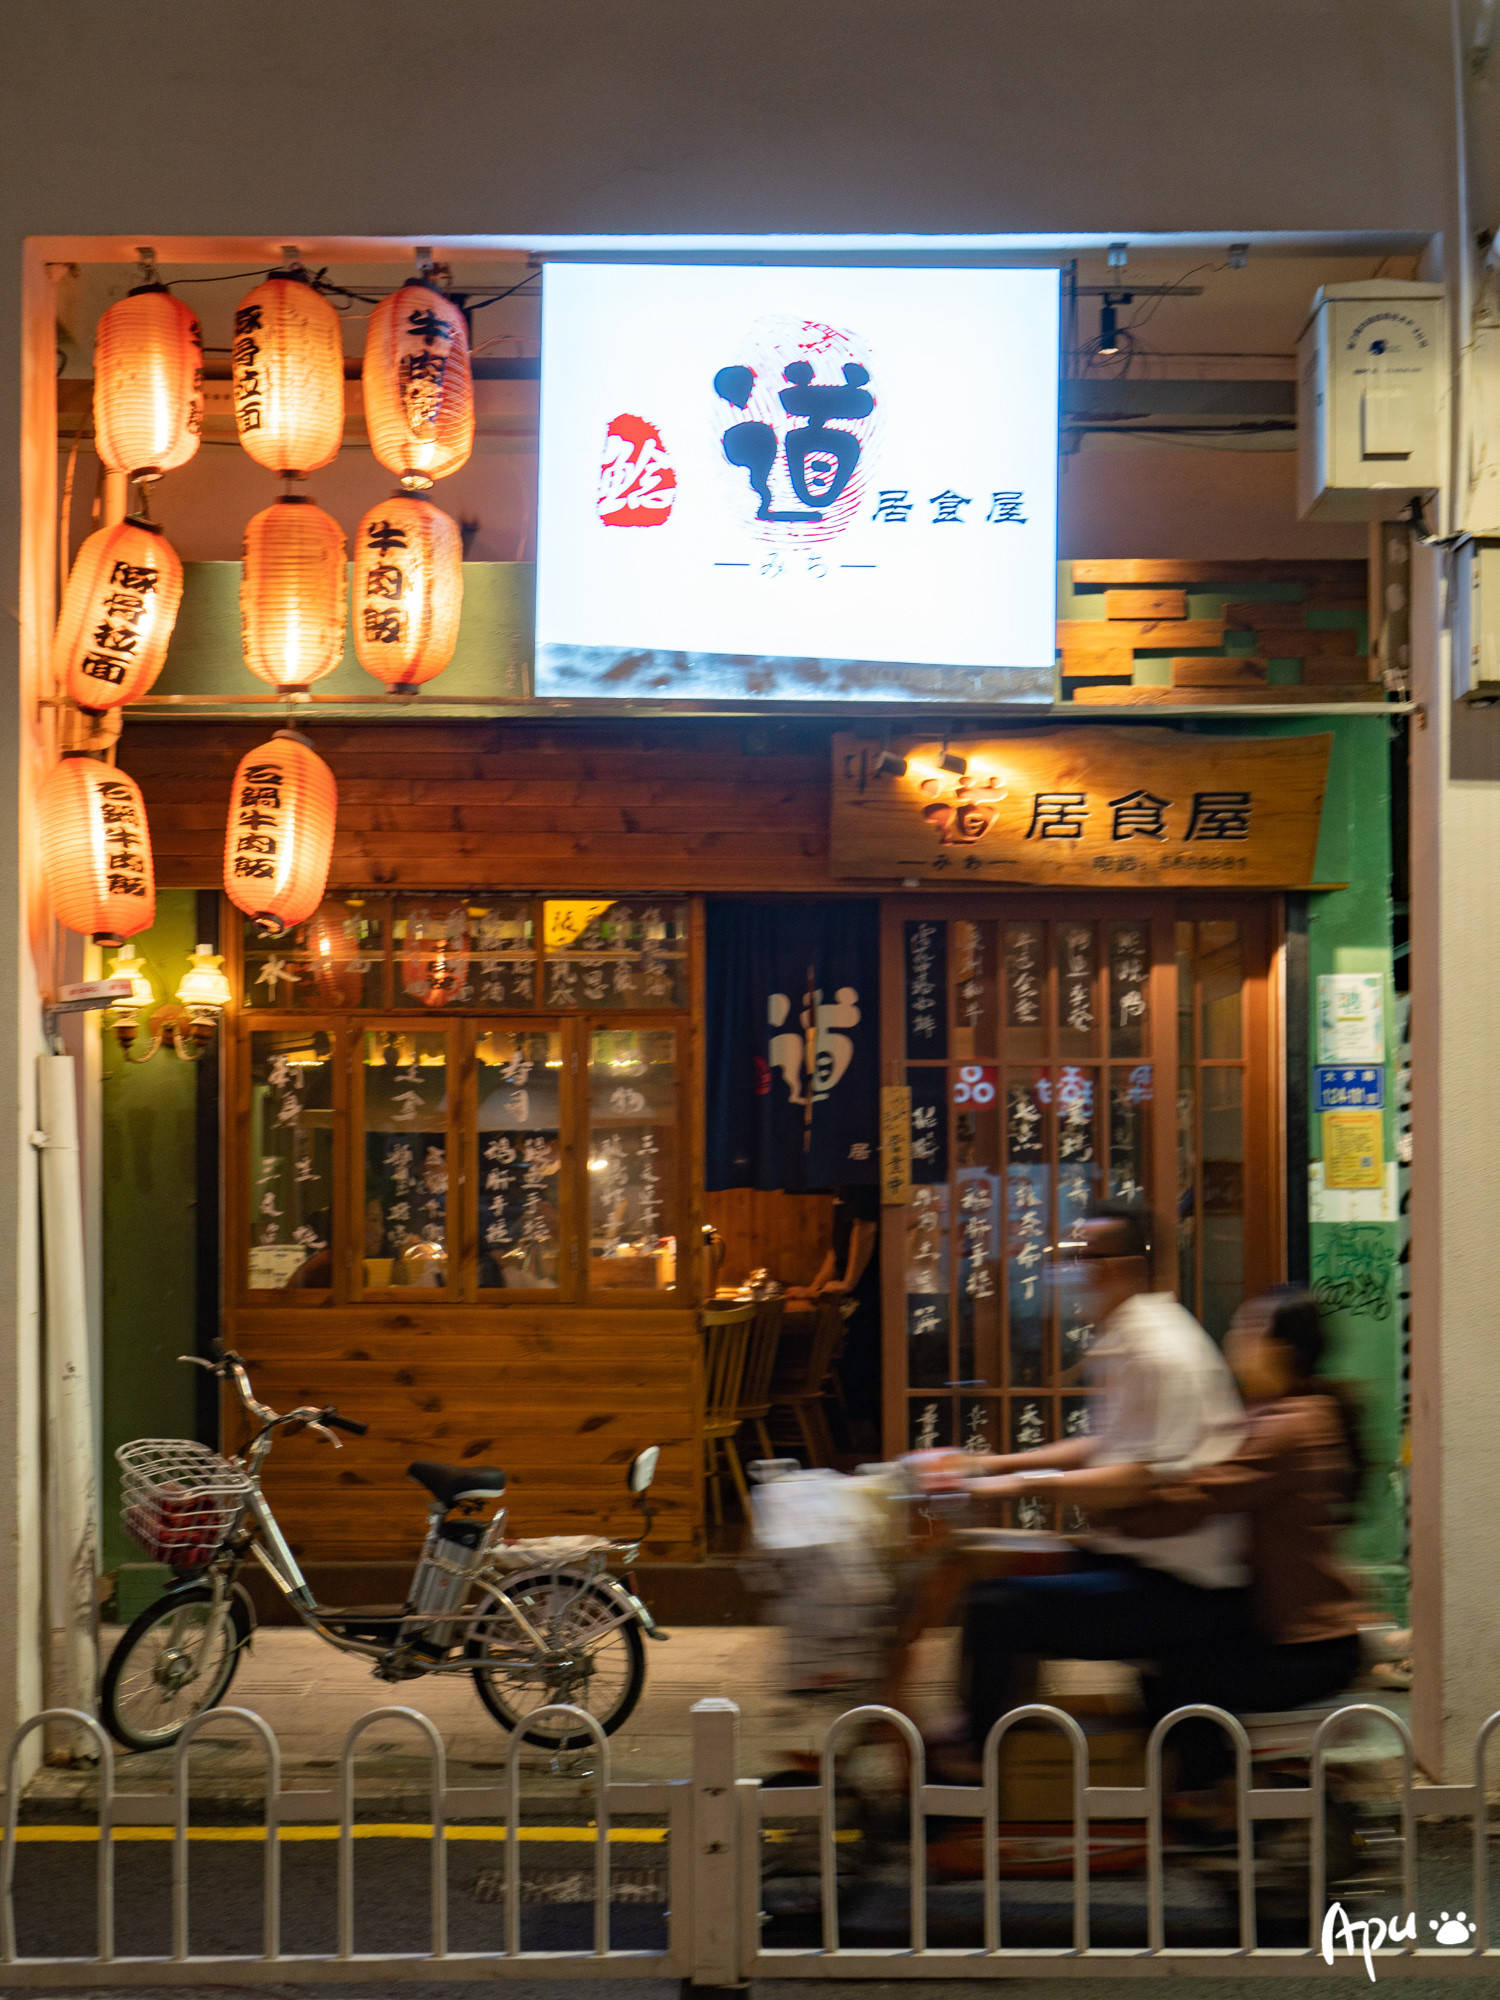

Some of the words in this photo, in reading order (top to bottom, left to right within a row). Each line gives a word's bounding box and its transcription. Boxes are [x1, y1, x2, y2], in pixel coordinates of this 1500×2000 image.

[713, 360, 877, 523] 道
[872, 490, 1031, 525] 居食屋
[1024, 790, 1253, 844] 居食屋
